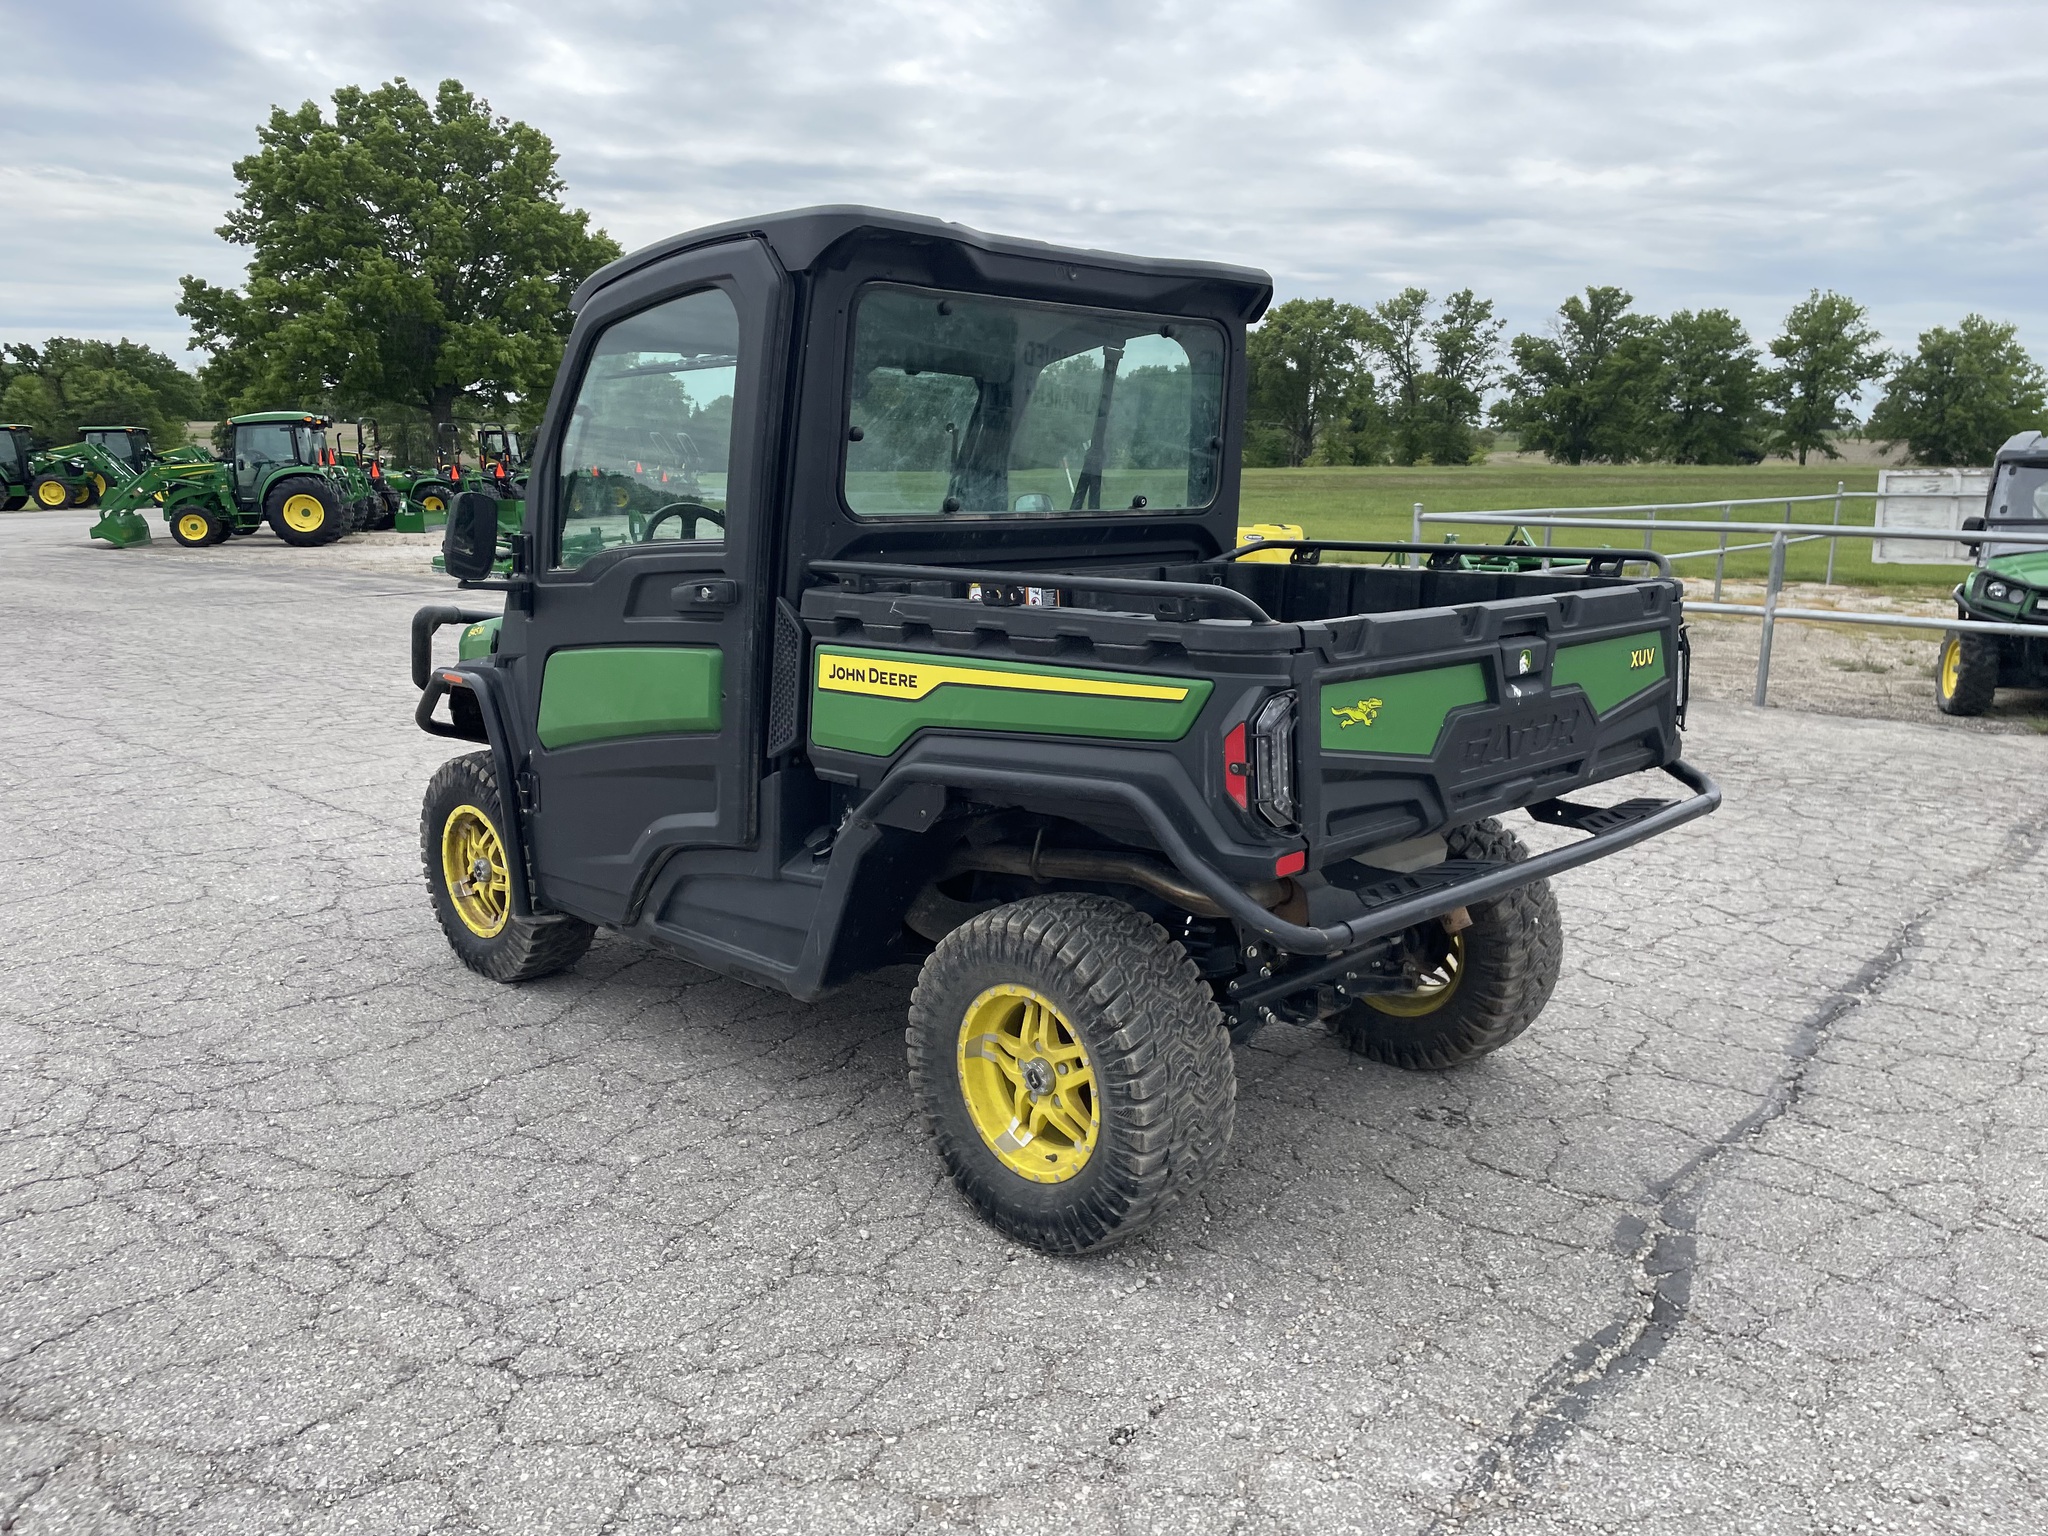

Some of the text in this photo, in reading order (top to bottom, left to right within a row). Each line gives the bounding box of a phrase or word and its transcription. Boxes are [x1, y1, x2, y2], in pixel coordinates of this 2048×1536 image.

[1630, 647, 1655, 668] XUV
[829, 664, 917, 688] JOHN DEERE
